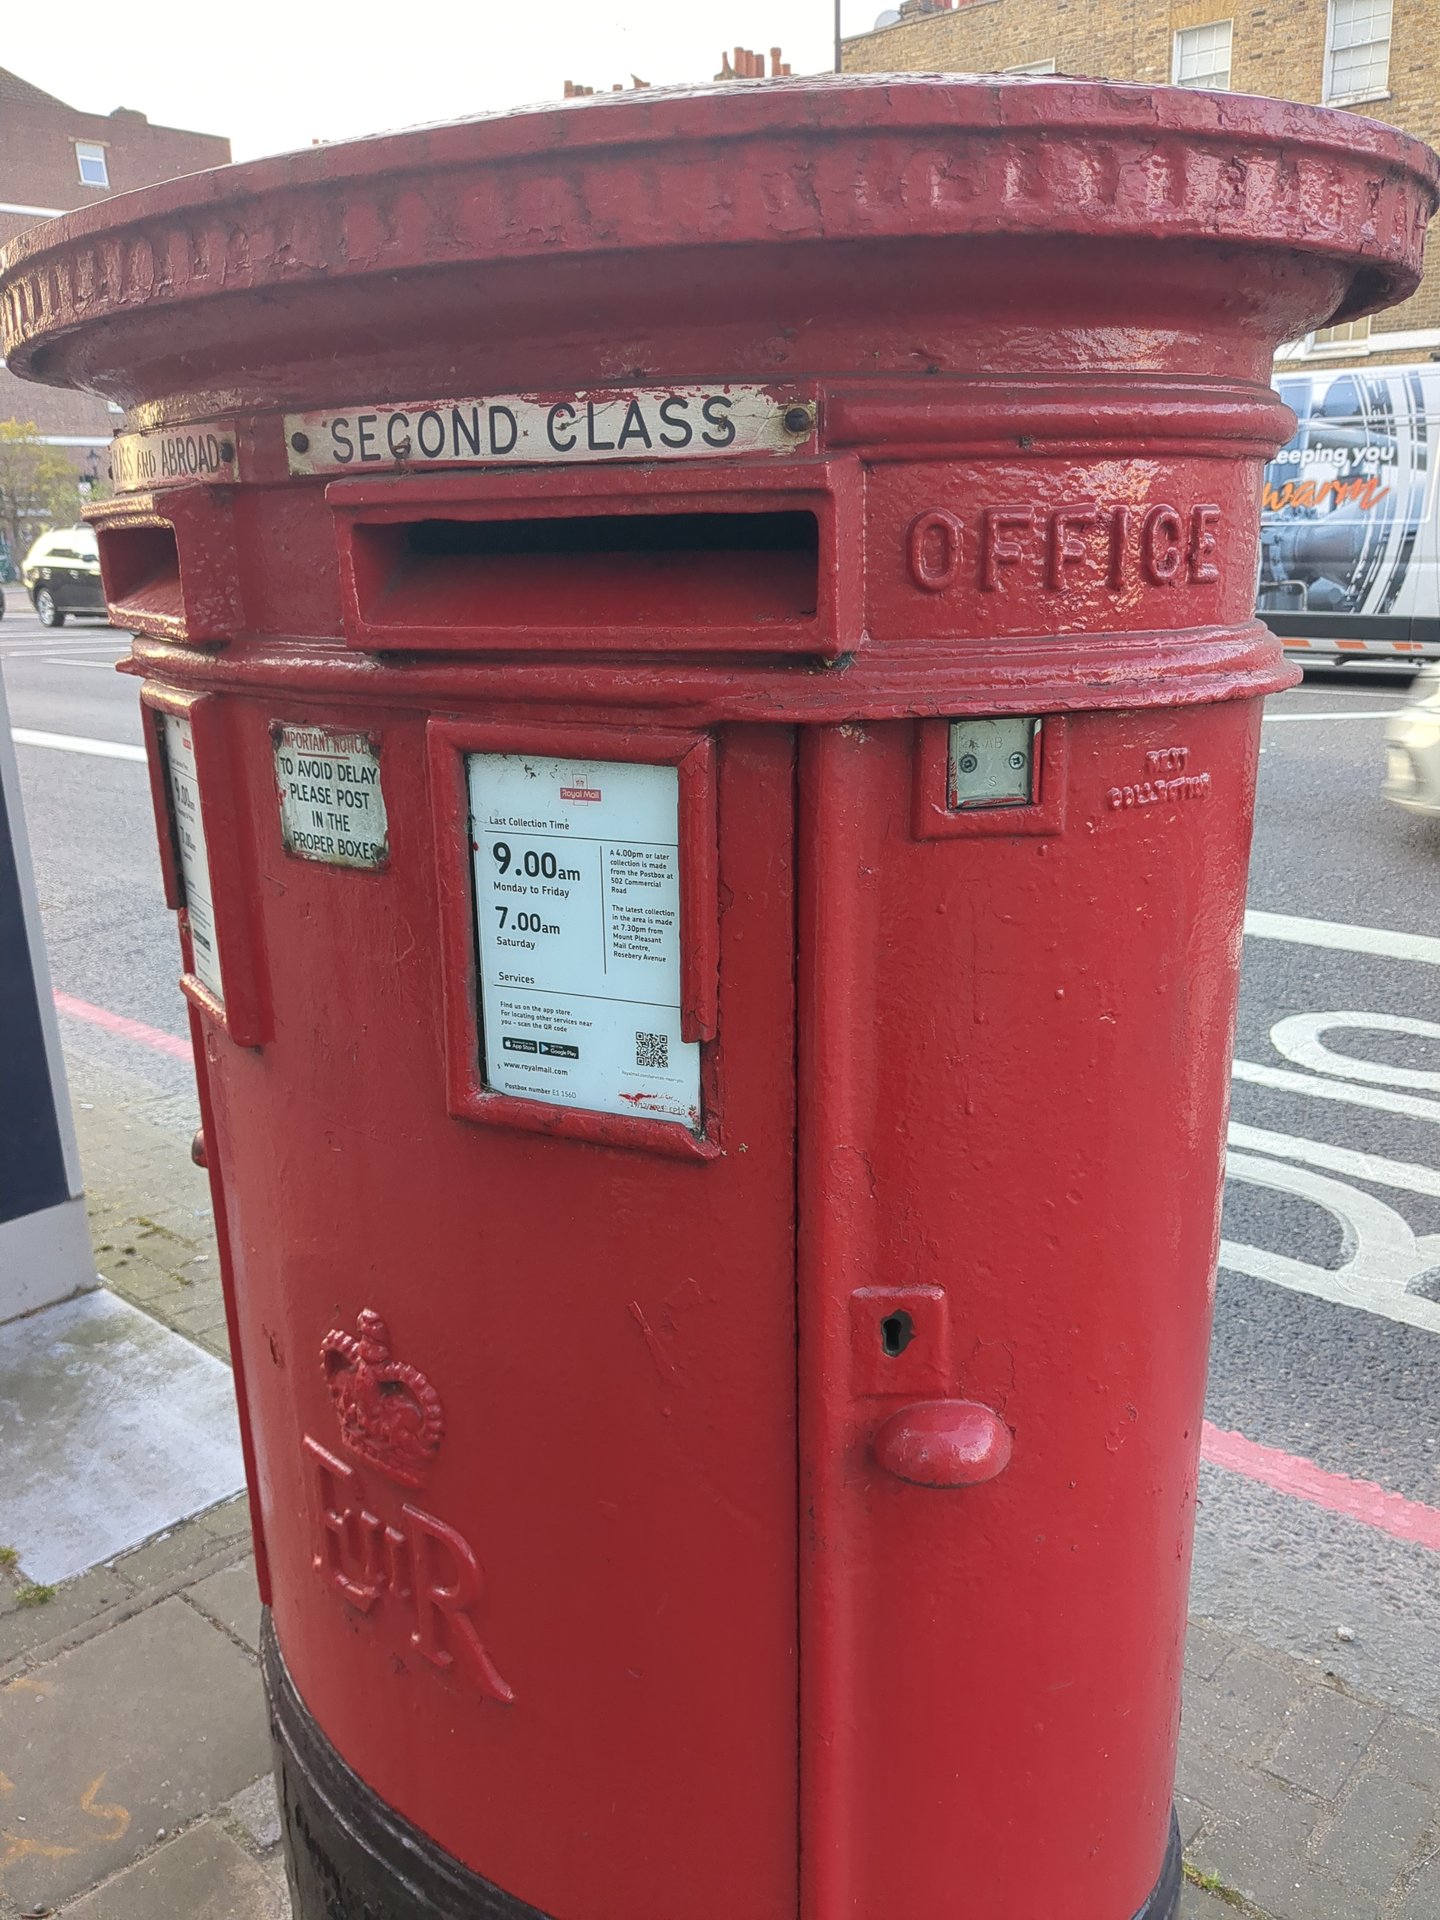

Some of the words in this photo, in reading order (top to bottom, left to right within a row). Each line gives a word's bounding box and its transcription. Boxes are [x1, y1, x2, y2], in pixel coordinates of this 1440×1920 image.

[330, 404, 518, 464] SECOND
[546, 394, 737, 453] CLASS
[161, 434, 220, 477] ABROAD
[1270, 442, 1348, 469] eeping
[1351, 445, 1395, 467] you
[1262, 477, 1391, 512] warm
[907, 502, 1221, 594] OFFICE
[334, 734, 367, 755] NOTICE
[280, 757, 294, 776] TO
[298, 759, 333, 780] AVOID
[337, 764, 378, 785] DELAY
[289, 783, 333, 806] PLEASE
[336, 789, 370, 810] POST
[562, 788, 583, 799] Royal
[583, 790, 600, 800] Mail
[312, 810, 324, 829] IN
[327, 812, 351, 832] THE
[489, 815, 507, 826] Last
[508, 817, 548, 829] Collection
[549, 820, 570, 831] Time
[293, 831, 335, 855] PROPER
[337, 838, 378, 860] BOXES
[492, 841, 581, 881] 9.00am
[616, 849, 644, 859] 4.00pm
[654, 852, 670, 860] later
[610, 859, 640, 868] collection
[649, 862, 667, 870] made
[610, 868, 626, 876] from
[627, 869, 638, 877] the
[639, 870, 665, 879] Postbox
[493, 881, 527, 895] Monday
[530, 885, 539, 894] to
[542, 885, 570, 899] Friday
[611, 886, 627, 894] Road
[624, 878, 662, 888] Commercial
[612, 904, 624, 912] The
[625, 905, 643, 914] latest
[644, 907, 675, 917] collection
[495, 905, 560, 935] 7.00am
[620, 914, 631, 922] the
[655, 918, 673, 926] made
[621, 923, 647, 934] 7.30pm
[647, 927, 664, 935] from
[496, 936, 536, 951] Saturday
[612, 933, 633, 941] Mount
[634, 934, 662, 944] Pleasant
[613, 950, 642, 961] Rosebery
[643, 954, 667, 963] Avenue
[498, 971, 535, 985] Services
[500, 1001, 513, 1009] Find
[543, 1007, 554, 1015] app
[501, 1009, 510, 1017] For
[511, 1011, 535, 1020] locating
[553, 1017, 577, 1026] services
[532, 1022, 542, 1030] the
[543, 1023, 553, 1031] QR
[503, 1061, 569, 1076] www.royalmail.com
[505, 1083, 527, 1092] Postbox
[528, 1086, 551, 1095] number
